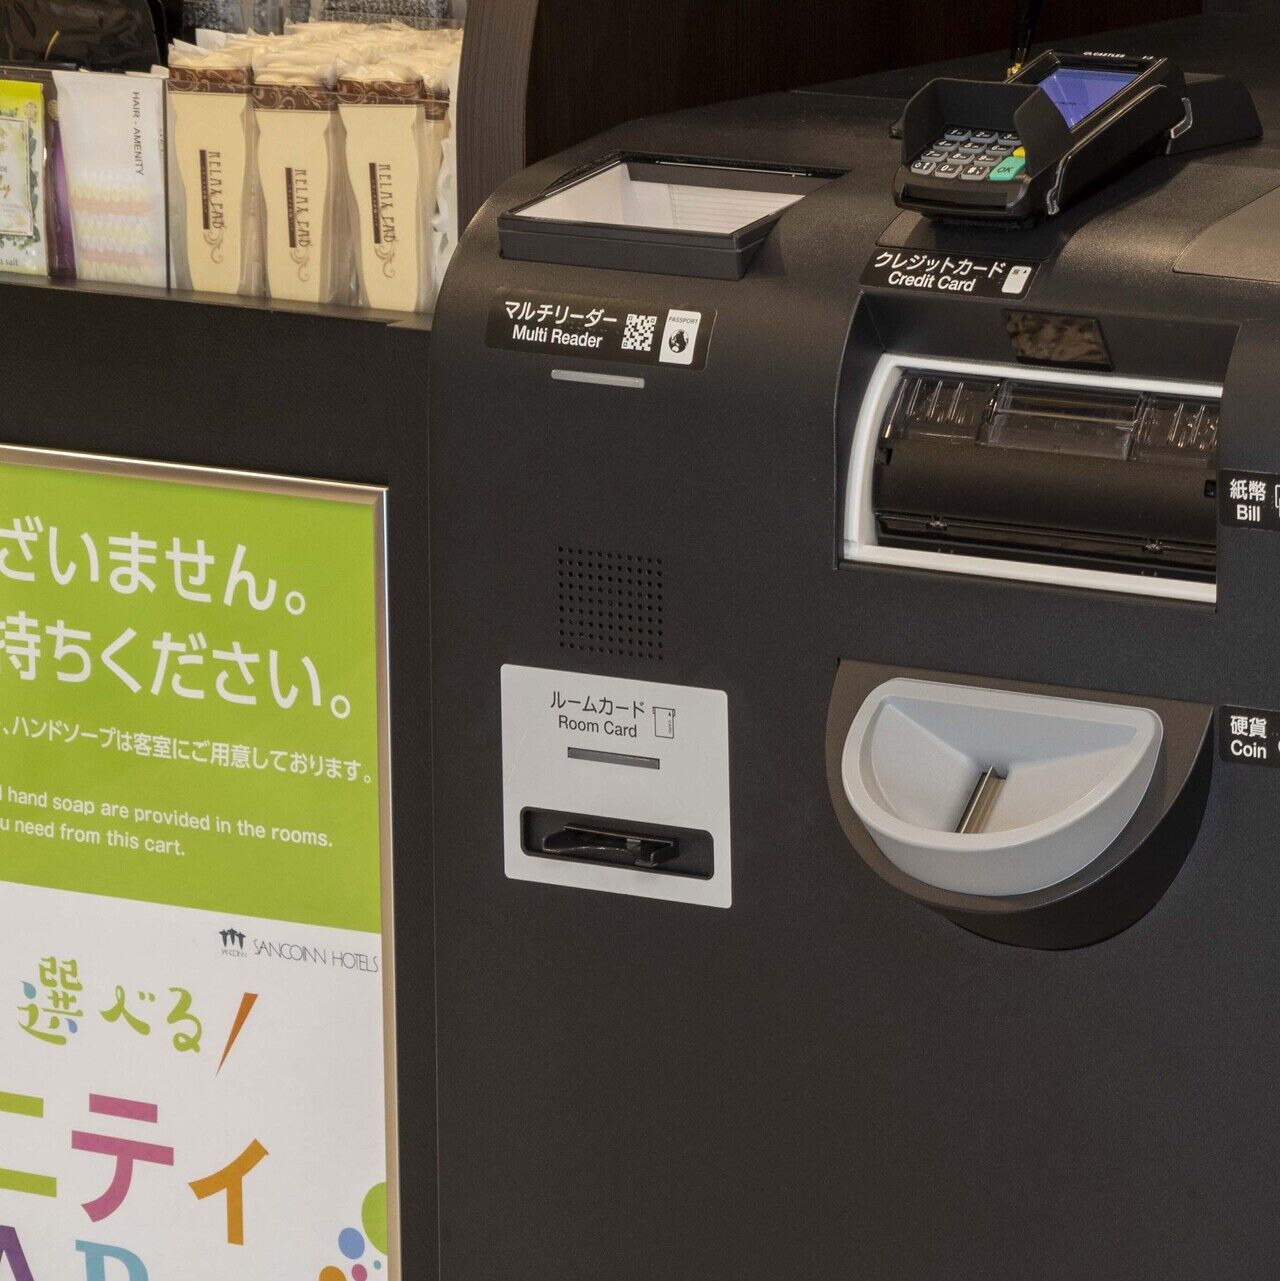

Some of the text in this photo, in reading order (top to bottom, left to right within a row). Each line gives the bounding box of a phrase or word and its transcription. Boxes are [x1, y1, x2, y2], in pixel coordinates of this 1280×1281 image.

[131, 91, 145, 176] HAIR AMENITY
[208, 151, 223, 195] RELAX
[379, 163, 394, 208] RELAX
[294, 168, 309, 213] RELAX
[874, 251, 1006, 278] クレジットカード
[888, 271, 977, 292] Credit Card
[504, 300, 618, 328] マルチリーダー
[668, 316, 699, 325] PASSPORT
[512, 324, 603, 349] Multi Reader
[1230, 479, 1267, 502] 紙幣
[1236, 504, 1261, 522] Bill
[0, 515, 307, 616] ざいません。
[0, 611, 352, 720] 持ちください。
[550, 690, 645, 719] ルームカード
[558, 715, 638, 738] Room Card
[1230, 715, 1267, 738] 硬貨
[1230, 739, 1267, 759] Coin
[8, 786, 333, 848] hand soap are provided in the rooms.
[15, 817, 186, 857] need from this cart.
[332, 950, 379, 974] HOTELS
[17, 956, 203, 1054] 選べる
[0, 1091, 270, 1247] ニティ
